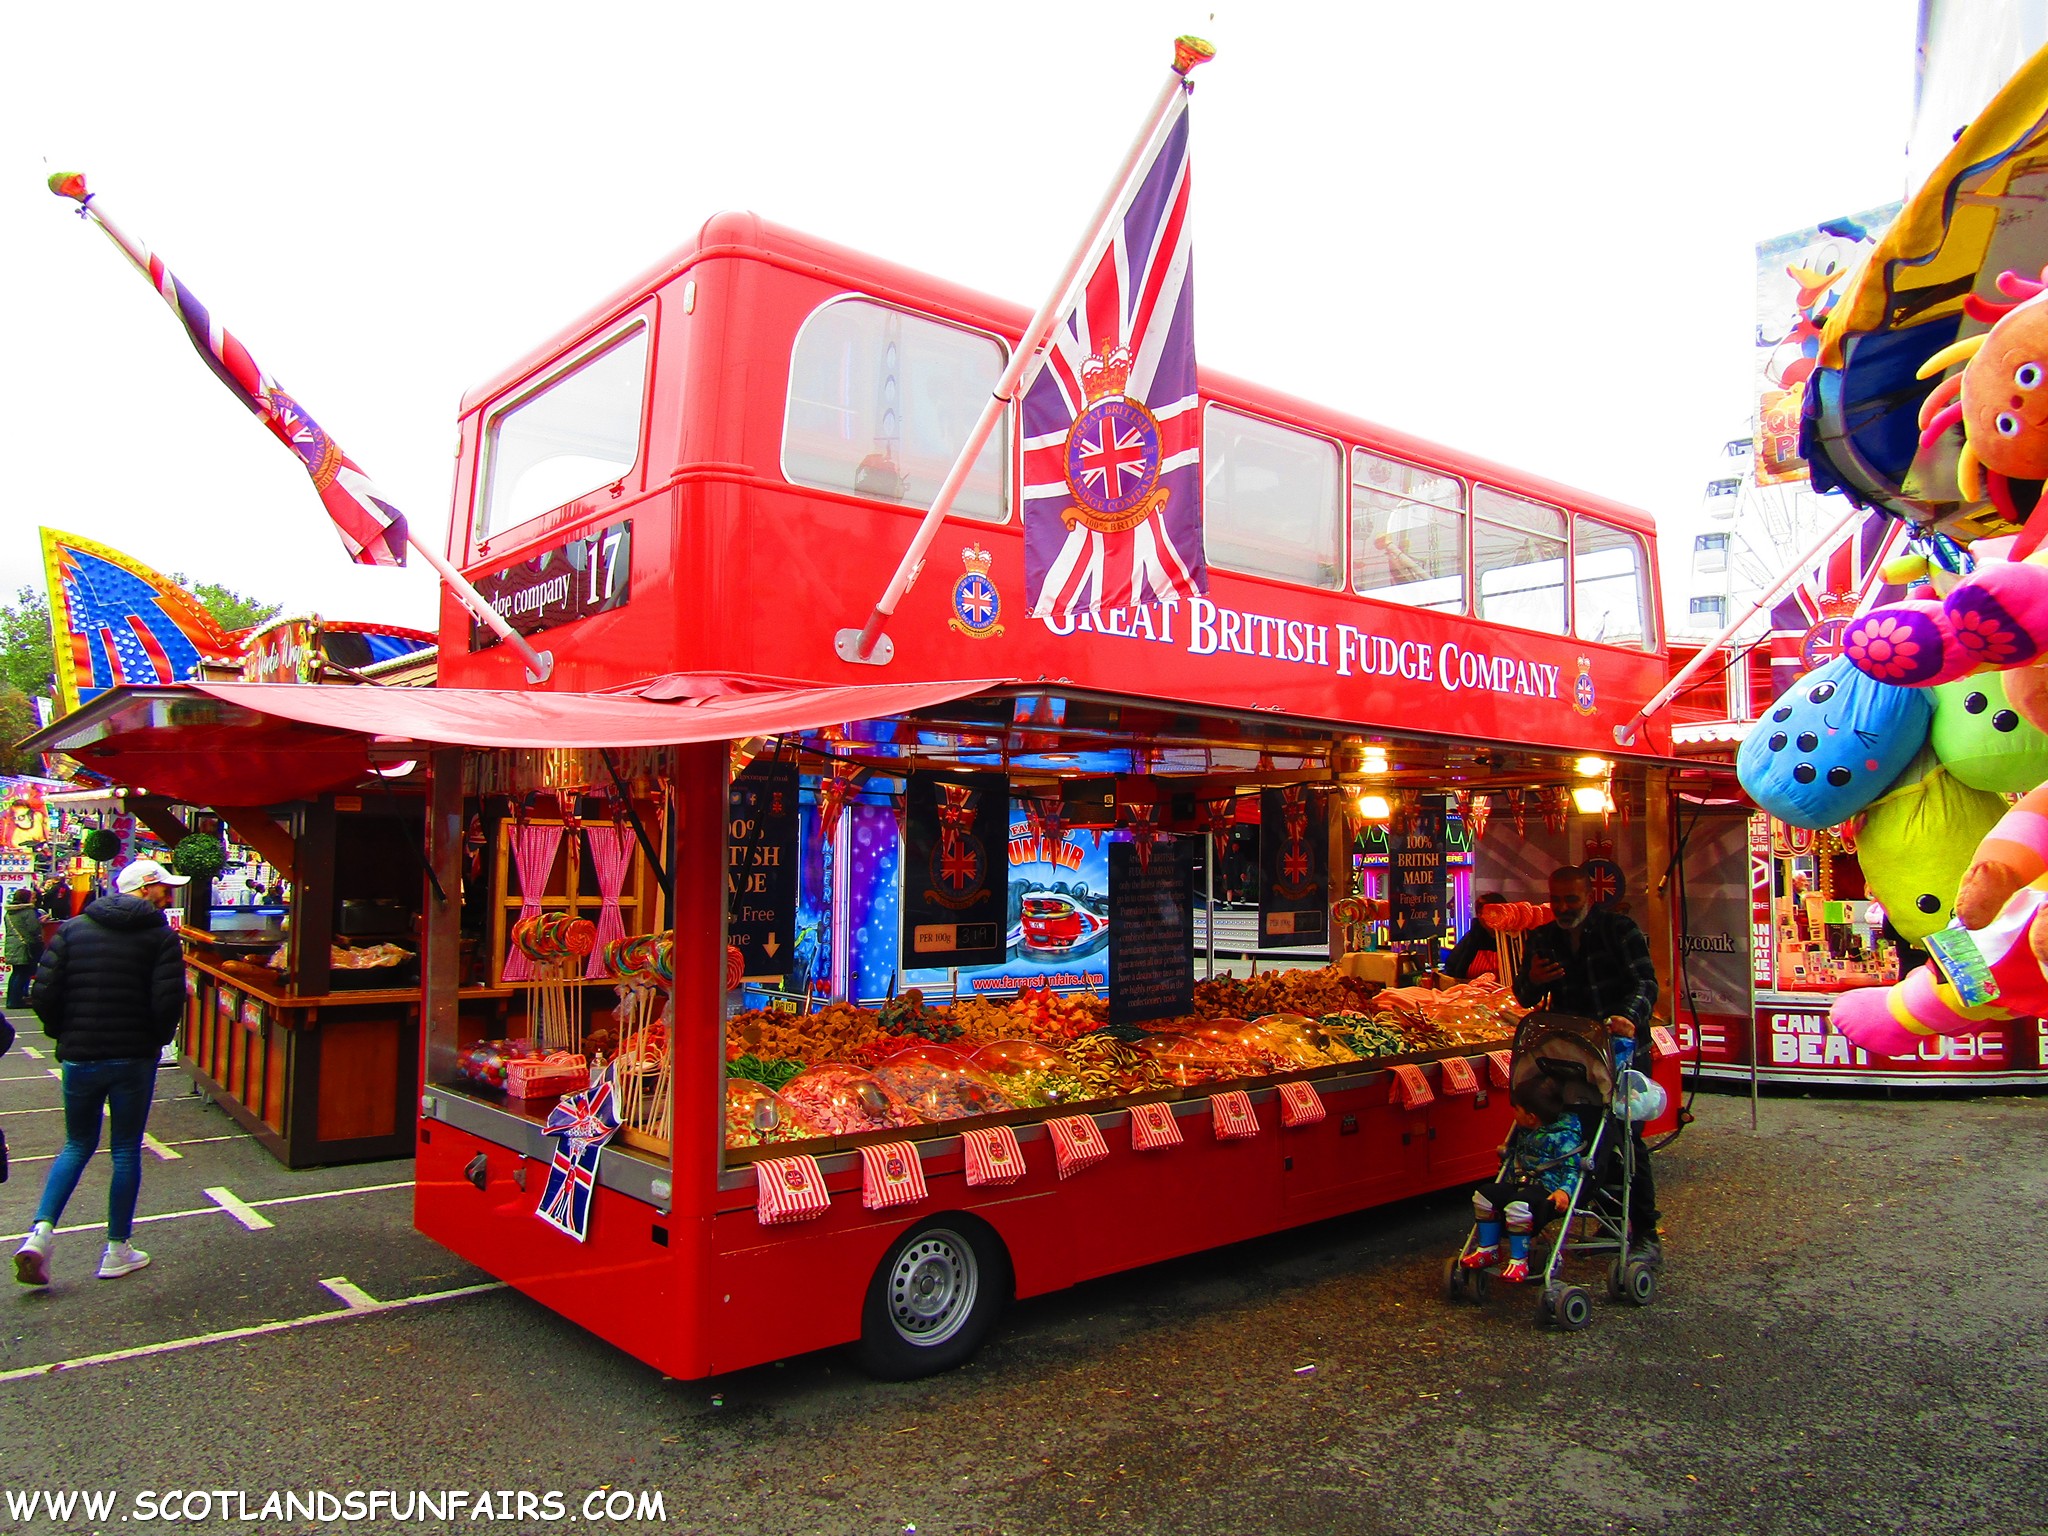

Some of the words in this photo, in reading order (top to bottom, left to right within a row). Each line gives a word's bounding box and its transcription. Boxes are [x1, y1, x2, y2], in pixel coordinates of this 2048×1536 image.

[1073, 409, 1102, 448] GREAT
[1104, 404, 1151, 434] BRITISH
[1074, 477, 1105, 511] FUDGE
[1107, 465, 1157, 512] COMPANY
[514, 573, 571, 618] company
[587, 532, 623, 606] 17
[1187, 597, 1329, 666] BRITISH
[1336, 624, 1434, 683] FUDGE
[1439, 642, 1560, 699] COMPANY
[1407, 835, 1433, 849] 100%
[1398, 853, 1439, 867] BRITISH
[1403, 871, 1434, 885] MADE
[1400, 893, 1421, 906] Finger
[1423, 892, 1438, 903] Free
[743, 907, 775, 921] Free
[1410, 909, 1428, 920] Zone
[919, 934, 933, 943] PER
[935, 933, 951, 944] 100g
[973, 974, 1103, 989] www.farrarsfnfairs.com
[1771, 1014, 1820, 1034] CAN
